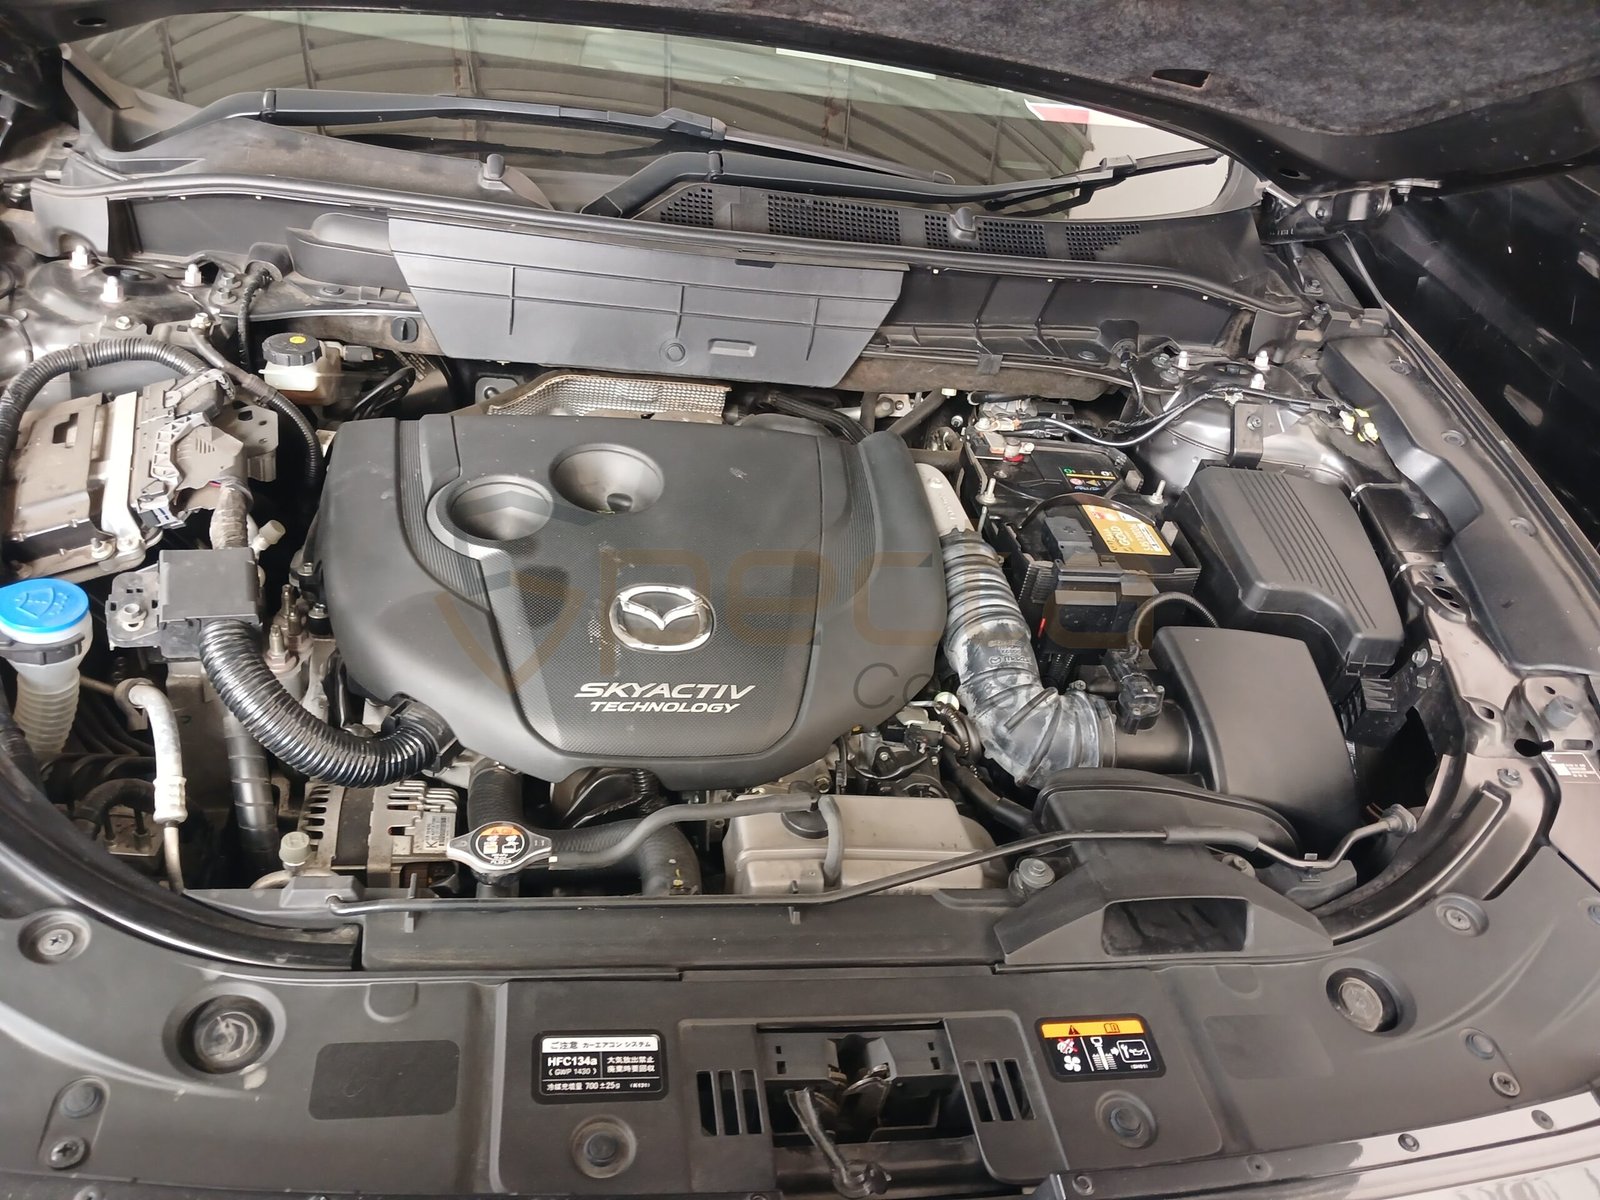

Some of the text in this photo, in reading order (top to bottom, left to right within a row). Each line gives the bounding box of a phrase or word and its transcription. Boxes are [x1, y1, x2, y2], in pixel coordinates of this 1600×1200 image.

[574, 682, 756, 700] SKYACTIV
[590, 701, 740, 713] TECHNOLOGY
[551, 1041, 578, 1049] ご注意
[547, 1056, 598, 1066] HFC134a
[607, 1056, 655, 1064] 大気放出禁止
